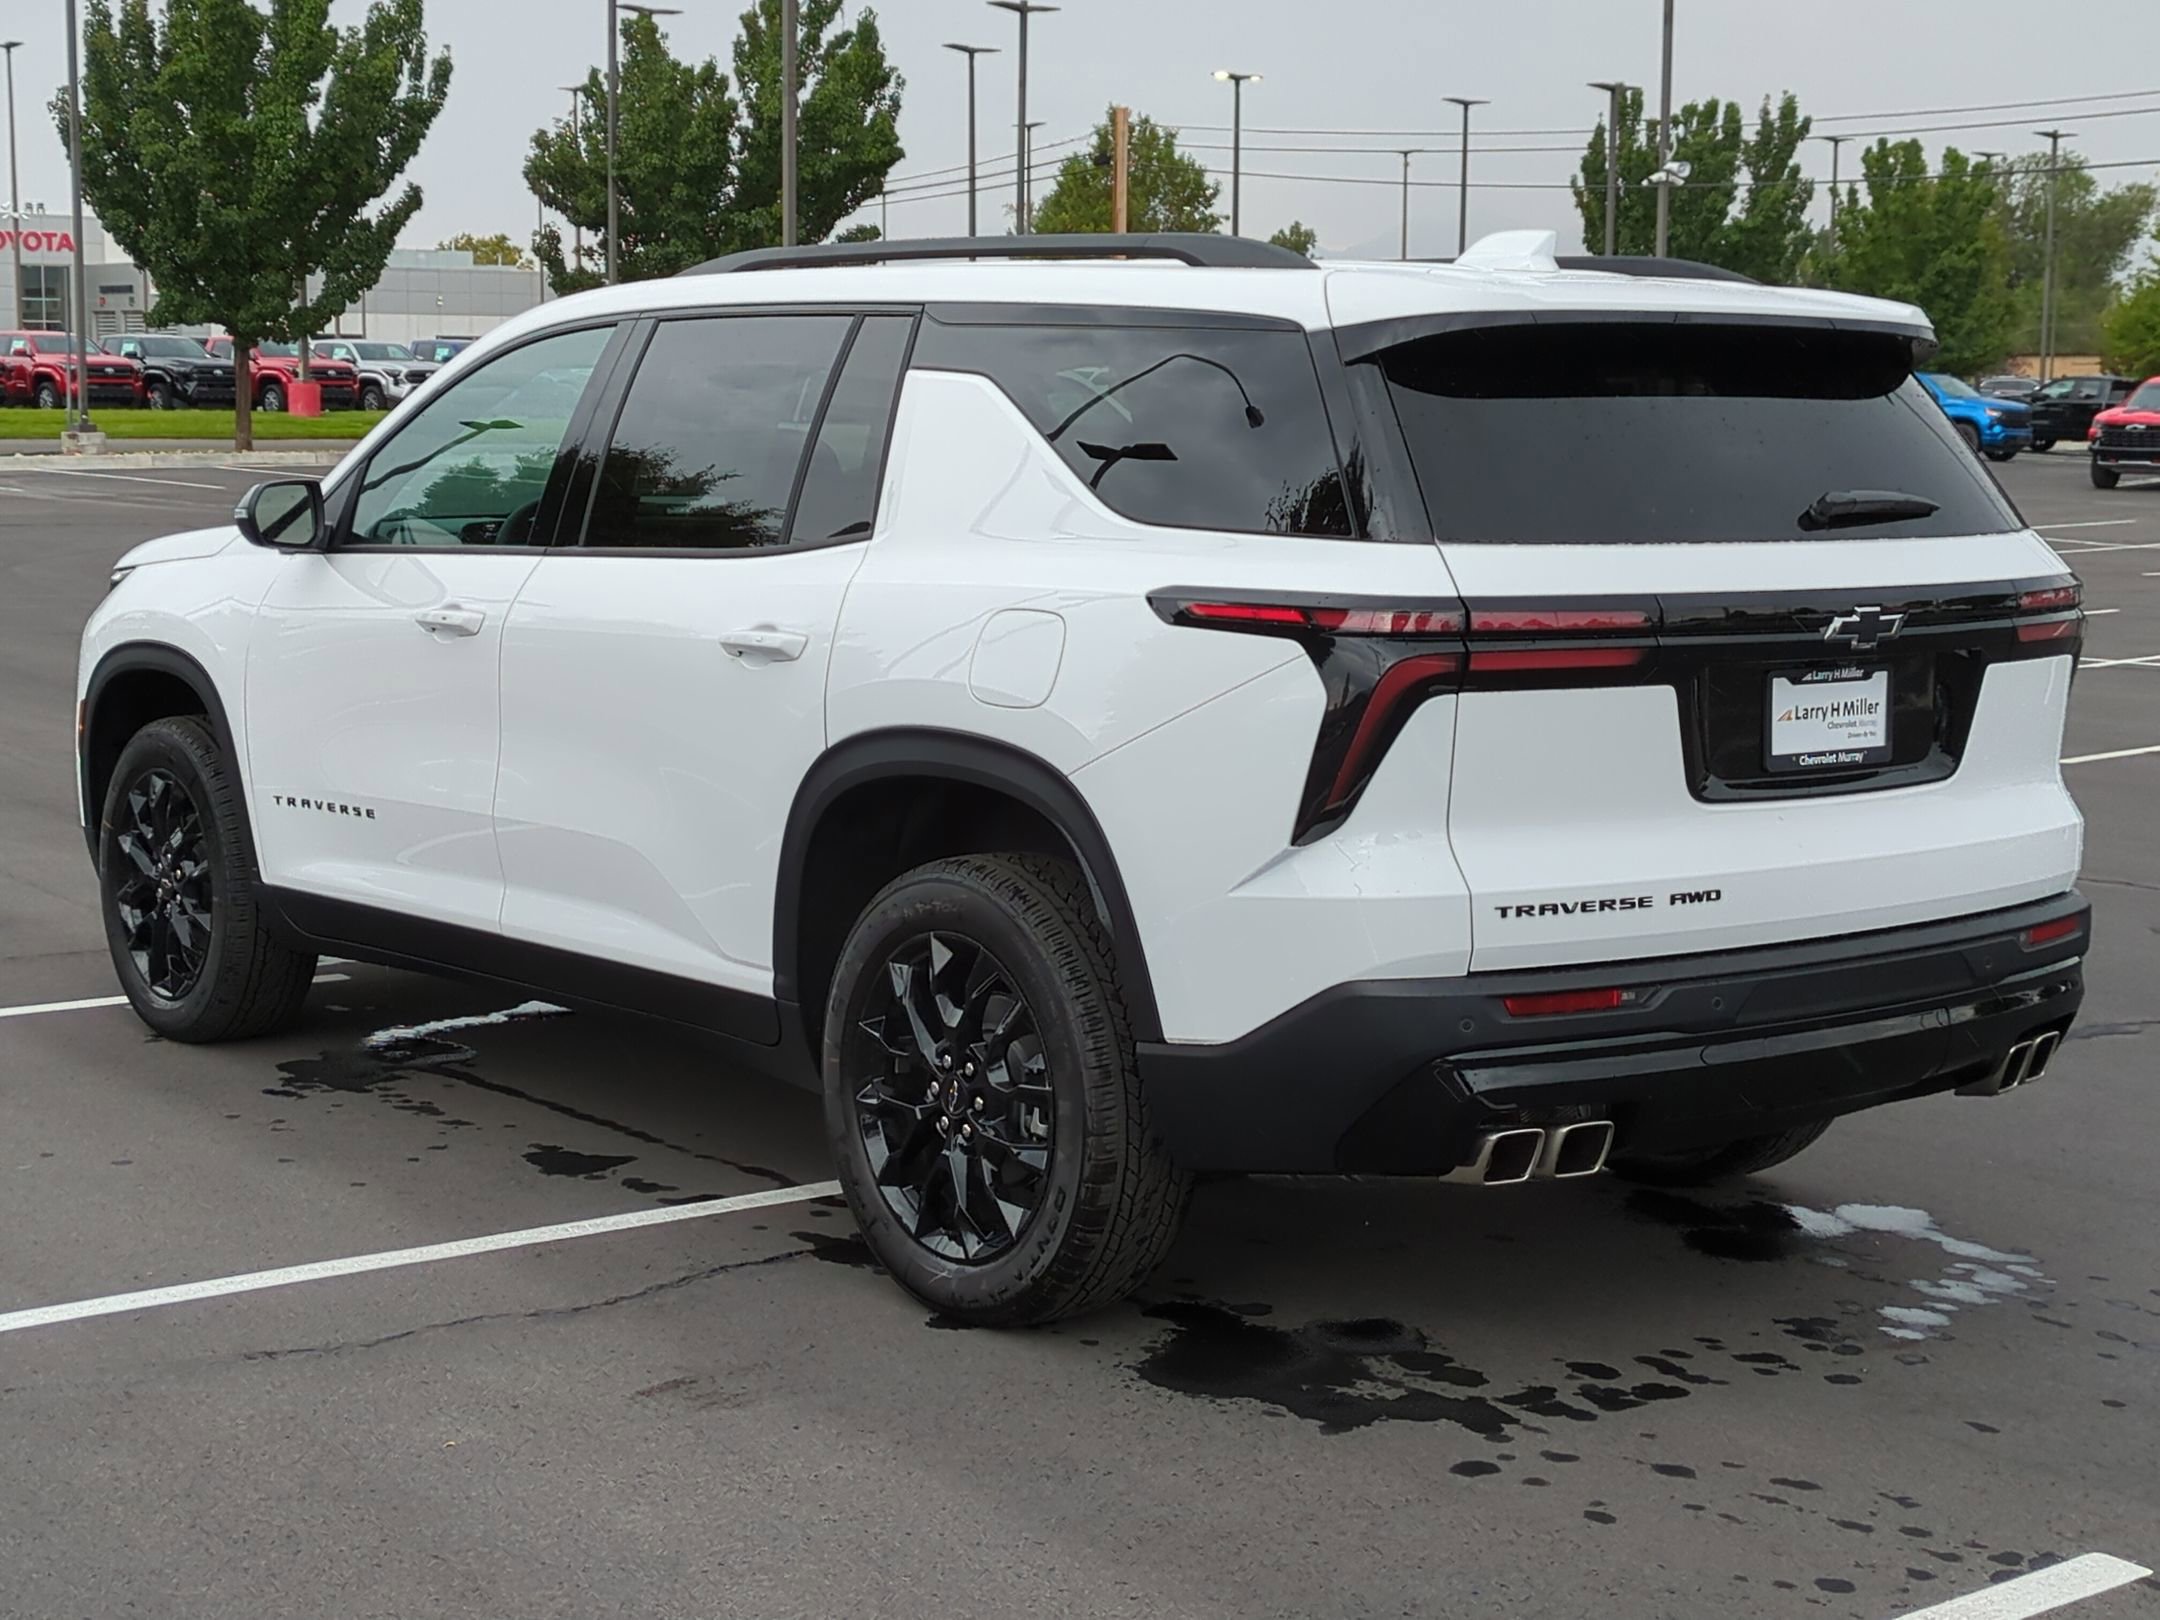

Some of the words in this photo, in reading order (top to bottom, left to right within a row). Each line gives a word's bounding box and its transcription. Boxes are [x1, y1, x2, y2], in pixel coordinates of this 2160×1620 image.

[1812, 670, 1833, 681] Larry
[1833, 668, 1841, 679] H
[1841, 667, 1864, 678] Miller
[1795, 705, 1828, 722] Larry
[1831, 701, 1840, 717] H
[1843, 698, 1879, 717] Miller
[1799, 752, 1837, 766] Chevrolet
[1838, 751, 1864, 763] Murray
[272, 795, 375, 819] TRAVERSE
[1494, 896, 1653, 919] TRAVERSE
[1669, 889, 1722, 906] AWD
